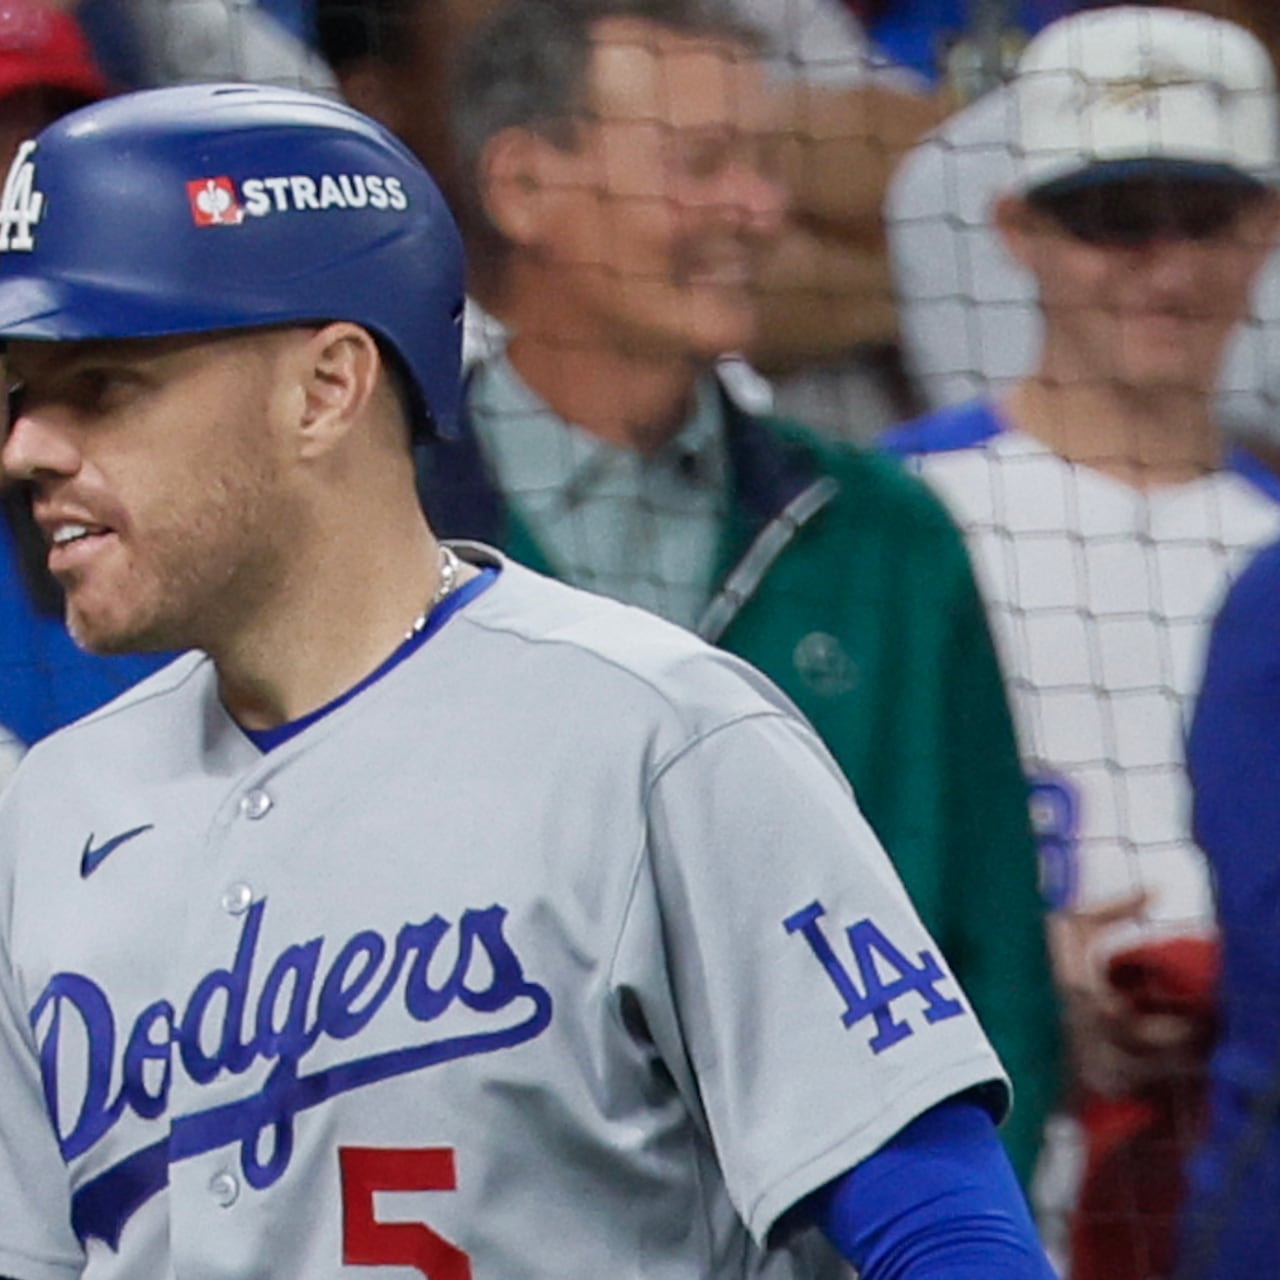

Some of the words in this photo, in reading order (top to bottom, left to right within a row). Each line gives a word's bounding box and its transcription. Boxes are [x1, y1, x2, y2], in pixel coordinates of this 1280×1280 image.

[241, 174, 408, 217] STRAUSS
[28, 896, 552, 1192] Dodgers
[782, 898, 966, 1057] LA
